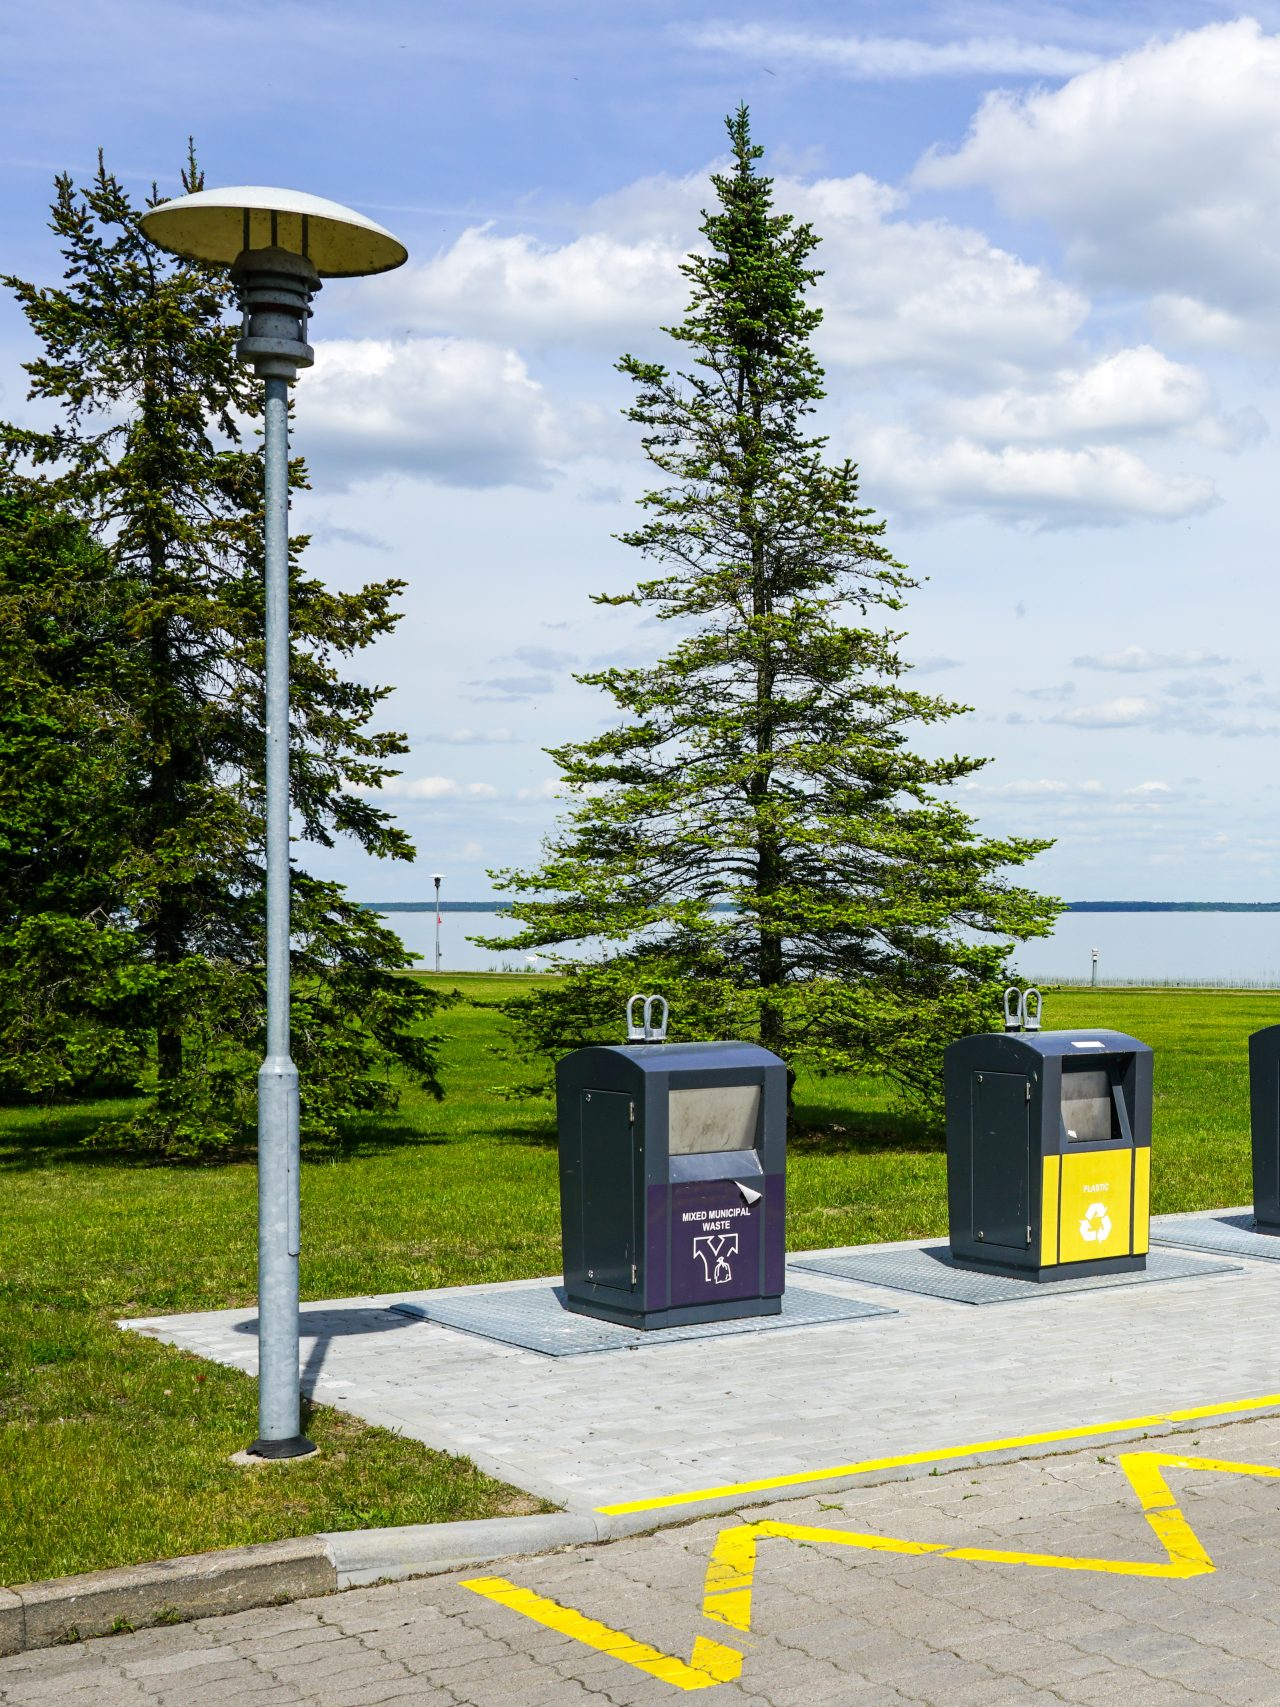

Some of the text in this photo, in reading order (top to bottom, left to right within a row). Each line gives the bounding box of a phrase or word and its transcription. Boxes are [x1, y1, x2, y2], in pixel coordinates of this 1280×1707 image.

[1083, 1184, 1109, 1192] PLASTIC
[682, 1207, 751, 1222] MIXED MUNICIPAL
[702, 1220, 731, 1232] WASTE
